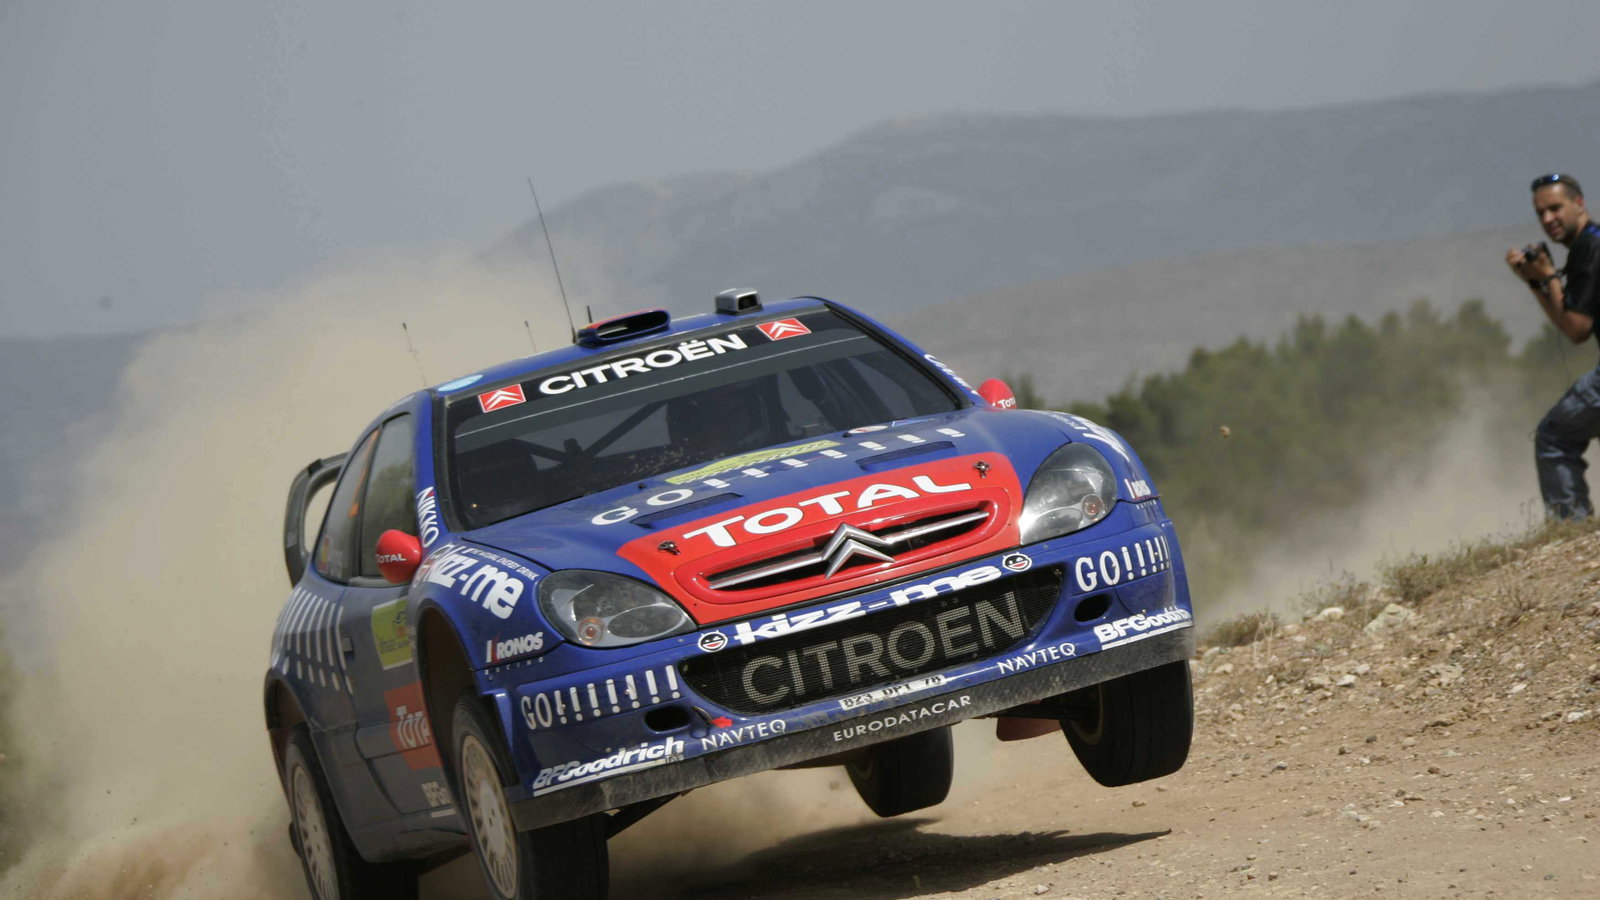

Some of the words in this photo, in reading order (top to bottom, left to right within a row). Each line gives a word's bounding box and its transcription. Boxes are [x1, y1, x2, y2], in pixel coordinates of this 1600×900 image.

[539, 333, 748, 395] CITROËN
[416, 486, 439, 548] NIKKO
[683, 475, 972, 548] TOTAL
[375, 553, 407, 564] TOTAL
[734, 565, 1002, 645] kizz-me
[741, 591, 1026, 705] CITROËN
[999, 642, 1077, 675] NAVTEQ
[701, 719, 786, 751] NAVTEQ
[833, 695, 971, 742] EURODATACAR
[532, 736, 685, 790] BFGoodrich
